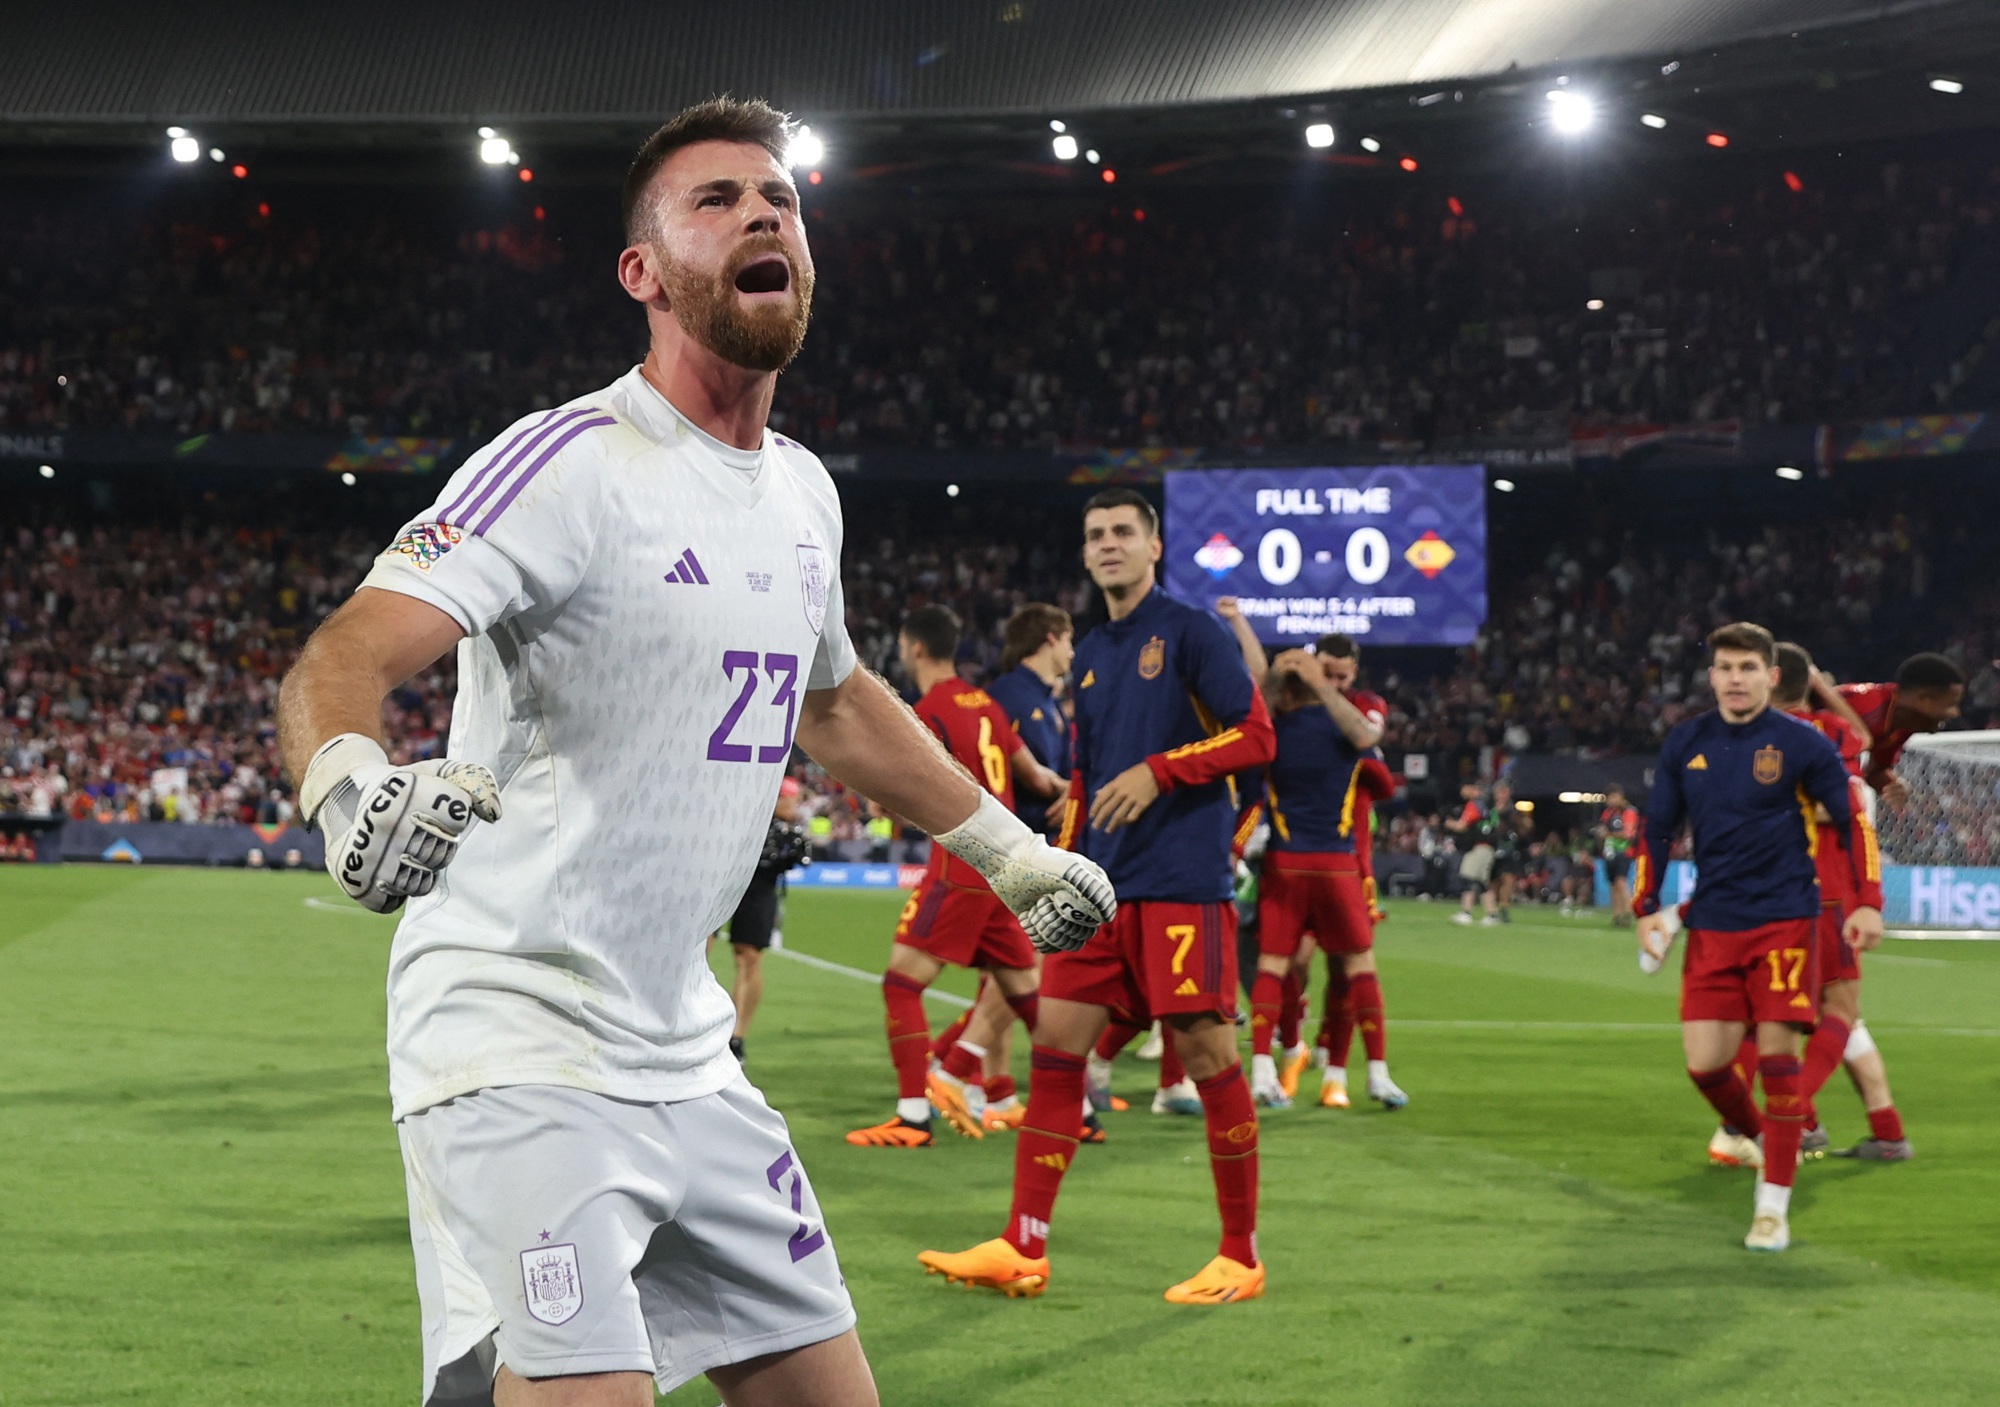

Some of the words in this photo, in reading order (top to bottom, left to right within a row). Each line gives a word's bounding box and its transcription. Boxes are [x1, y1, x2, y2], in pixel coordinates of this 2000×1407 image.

[1256, 488, 1324, 516] FULL
[1325, 487, 1391, 515] TIME
[1258, 528, 1302, 586] 0
[1345, 526, 1390, 586] 0
[1276, 614, 1371, 634] PENALTIES
[1288, 597, 1327, 616] WIN
[1357, 596, 1415, 616] AFTER
[706, 650, 798, 764] 23
[978, 716, 1006, 794] 6
[342, 776, 407, 888] reusch
[432, 793, 471, 826] re
[1910, 866, 2000, 928] Hise
[1166, 925, 1196, 975] 7
[1766, 948, 1807, 992] 17
[766, 1150, 825, 1263] 2
